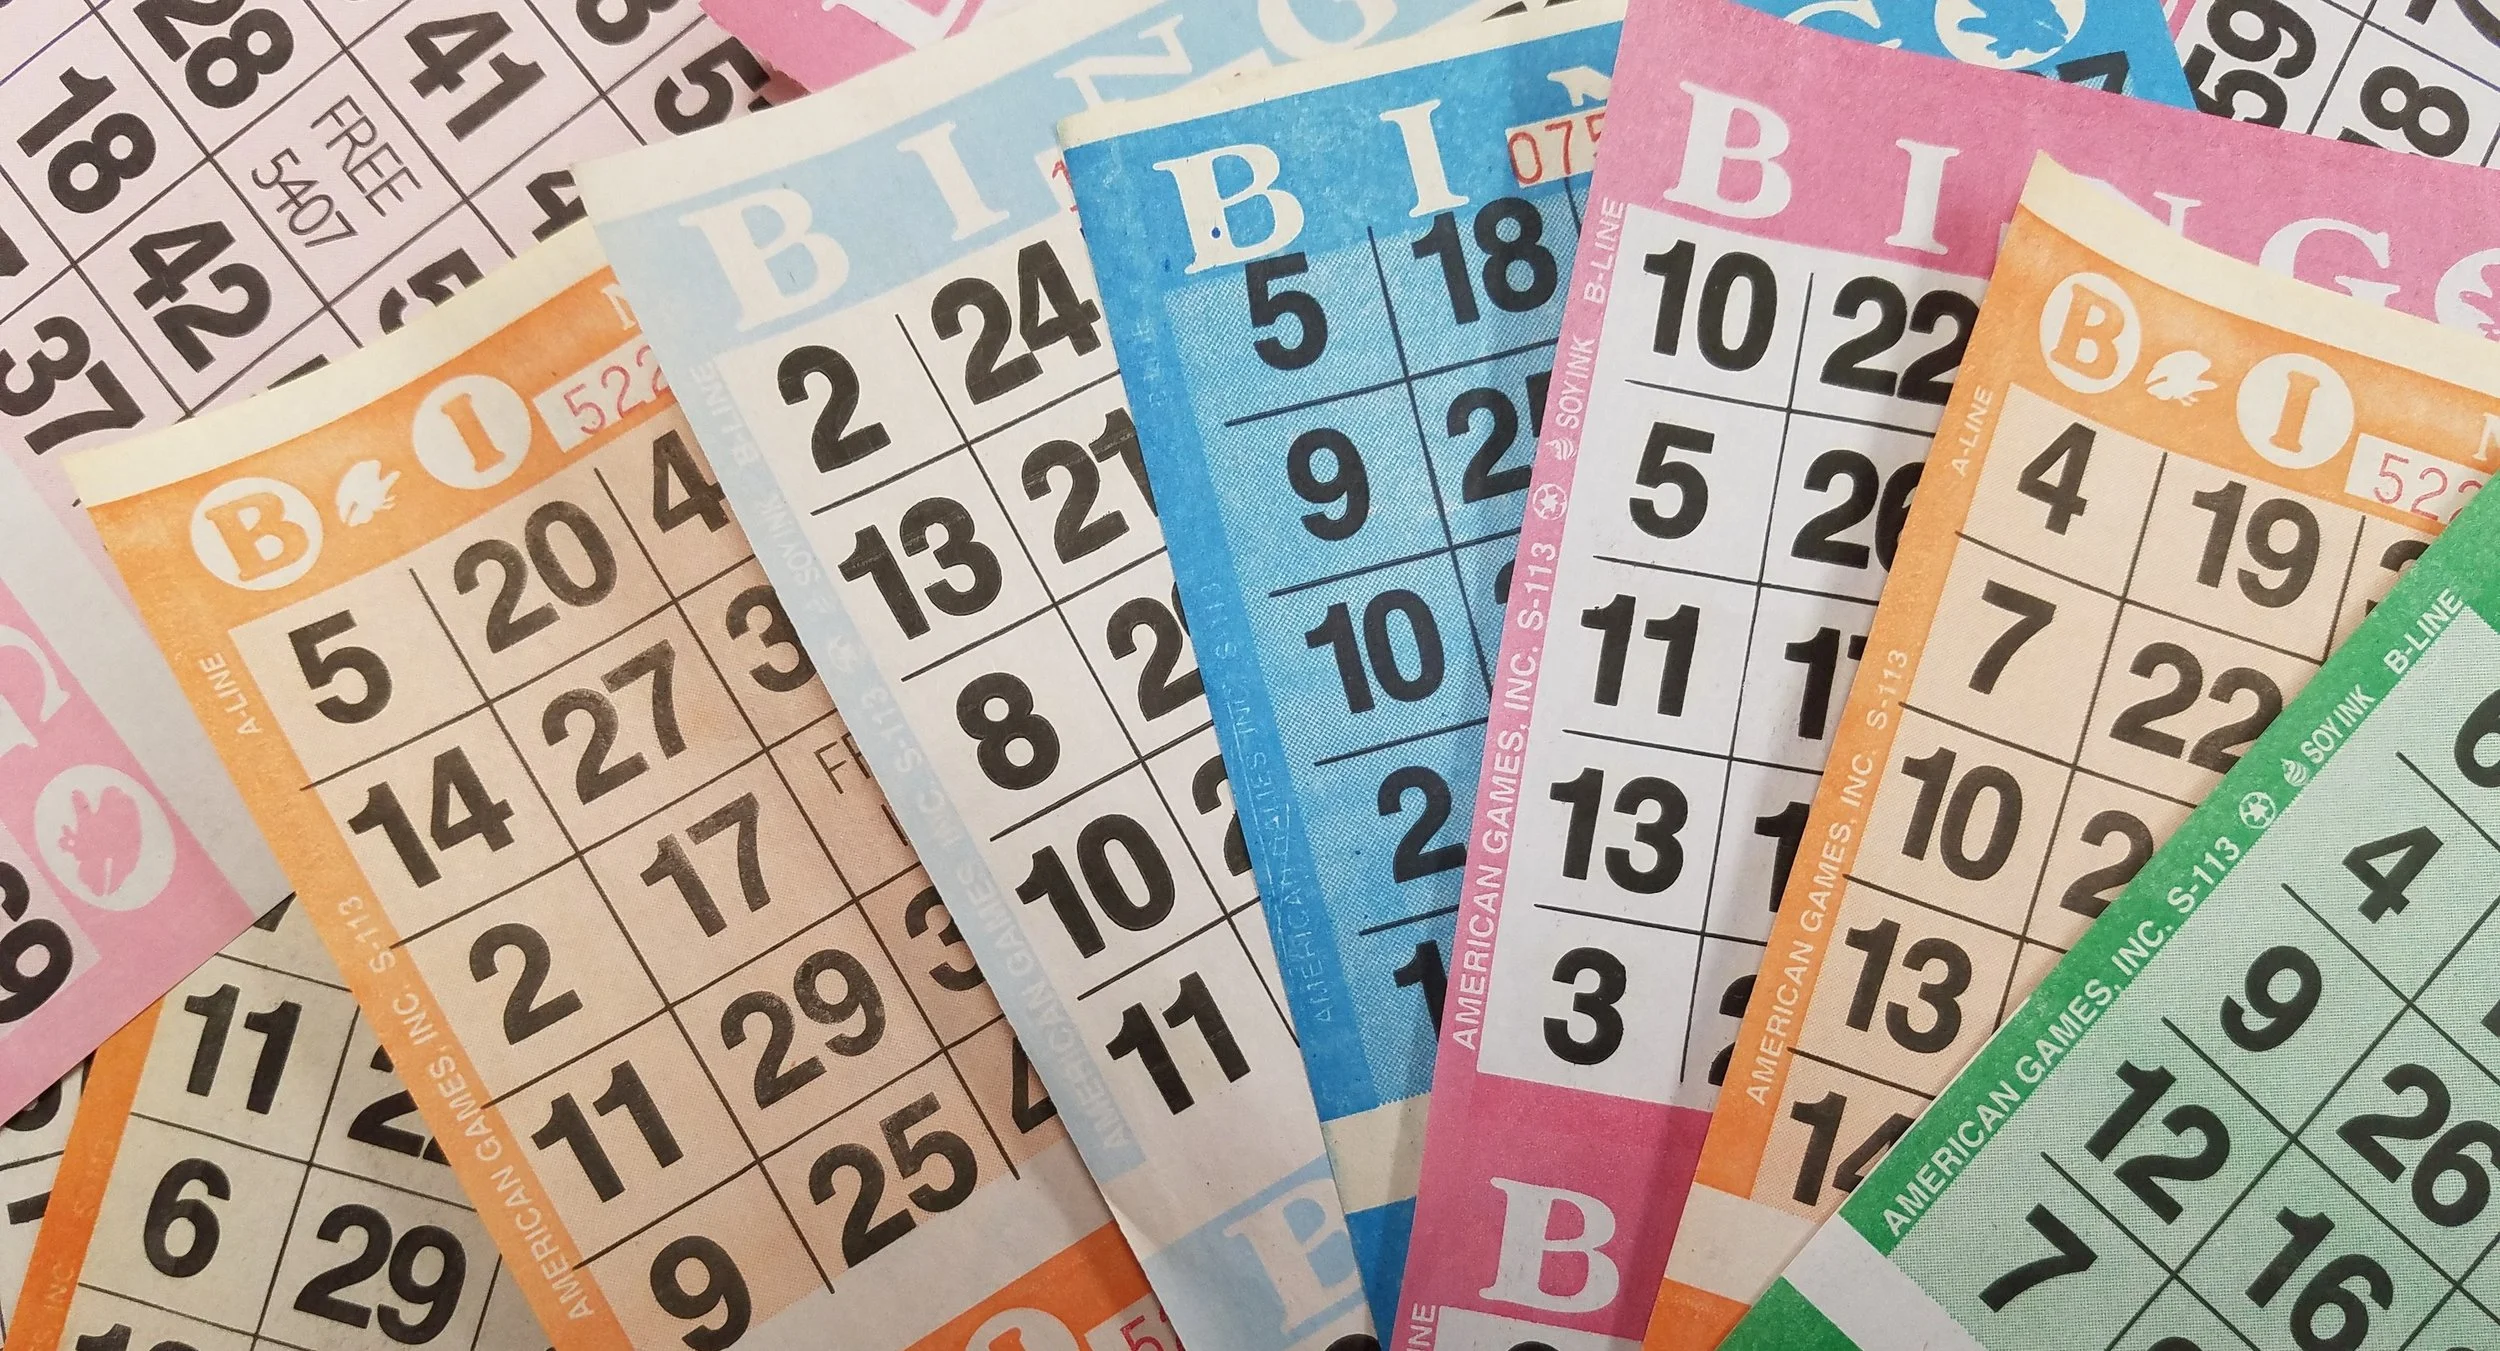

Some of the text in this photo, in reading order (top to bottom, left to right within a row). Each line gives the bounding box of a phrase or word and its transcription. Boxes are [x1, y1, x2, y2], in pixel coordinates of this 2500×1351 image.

[16, 67, 156, 214] 18
[405, 11, 547, 141] 41
[252, 148, 358, 248] 5407
[311, 96, 422, 218] FREE
[1153, 143, 1304, 275] B
[1380, 100, 1469, 218] I
[1664, 79, 1792, 218] B
[1885, 138, 1960, 255] I
[129, 220, 272, 373] 42
[777, 344, 891, 473] 2
[931, 239, 1102, 406] 24
[1245, 252, 1327, 371] 5
[1412, 198, 1557, 325] 18
[1642, 239, 1978, 402] 10 22
[0, 315, 146, 455] 37
[2050, 283, 2321, 453] B I
[204, 391, 506, 581] B I
[1286, 428, 1369, 541] 9
[1629, 422, 1716, 539] 5
[2016, 421, 2097, 536] 4
[2192, 481, 2319, 608] 19
[288, 609, 394, 724] 5
[453, 499, 618, 653] 20
[837, 497, 1002, 640] 13
[1453, 865, 1504, 1050] AMERICAN
[1517, 542, 1556, 630] S-113
[1583, 197, 1625, 304] B-LINE
[198, 650, 261, 736] A-LINE
[955, 672, 1060, 791] 8
[1106, 580, 1207, 721] 2
[1306, 589, 1444, 714] 10
[1580, 593, 1867, 740] 11 1
[1968, 579, 2283, 774] 7 22
[348, 745, 517, 888] 14
[541, 639, 687, 805] 27
[1745, 938, 1814, 1106] AMERICAN
[1867, 648, 1908, 731] S-113
[1952, 385, 1995, 478] A-LINE
[1901, 746, 2023, 881] 10
[1015, 813, 1175, 959] 10
[1377, 766, 1466, 884] 2
[1549, 767, 1688, 894] 13
[2342, 825, 2444, 924] 4
[338, 896, 396, 973] S-113
[469, 792, 771, 1045] 2 17
[1845, 918, 1973, 1053] 13
[1882, 1081, 2021, 1236] AMERICAN
[2167, 836, 2240, 912] S-113
[2383, 588, 2464, 676] B-LINE
[183, 984, 302, 1115] 11
[1105, 971, 1251, 1115] 11
[1543, 947, 1626, 1065] 3
[2219, 946, 2322, 1052] 9
[531, 1060, 683, 1203] 11
[720, 949, 886, 1109] 29
[2084, 1059, 2500, 1227] 12 26
[143, 1157, 231, 1277] 6
[294, 1204, 466, 1345] 29
[490, 1165, 594, 1321] AMERICAN
[649, 1092, 978, 1351] 9 25
[1478, 1177, 1620, 1312] B
[1979, 1203, 2393, 1351] 7 16
